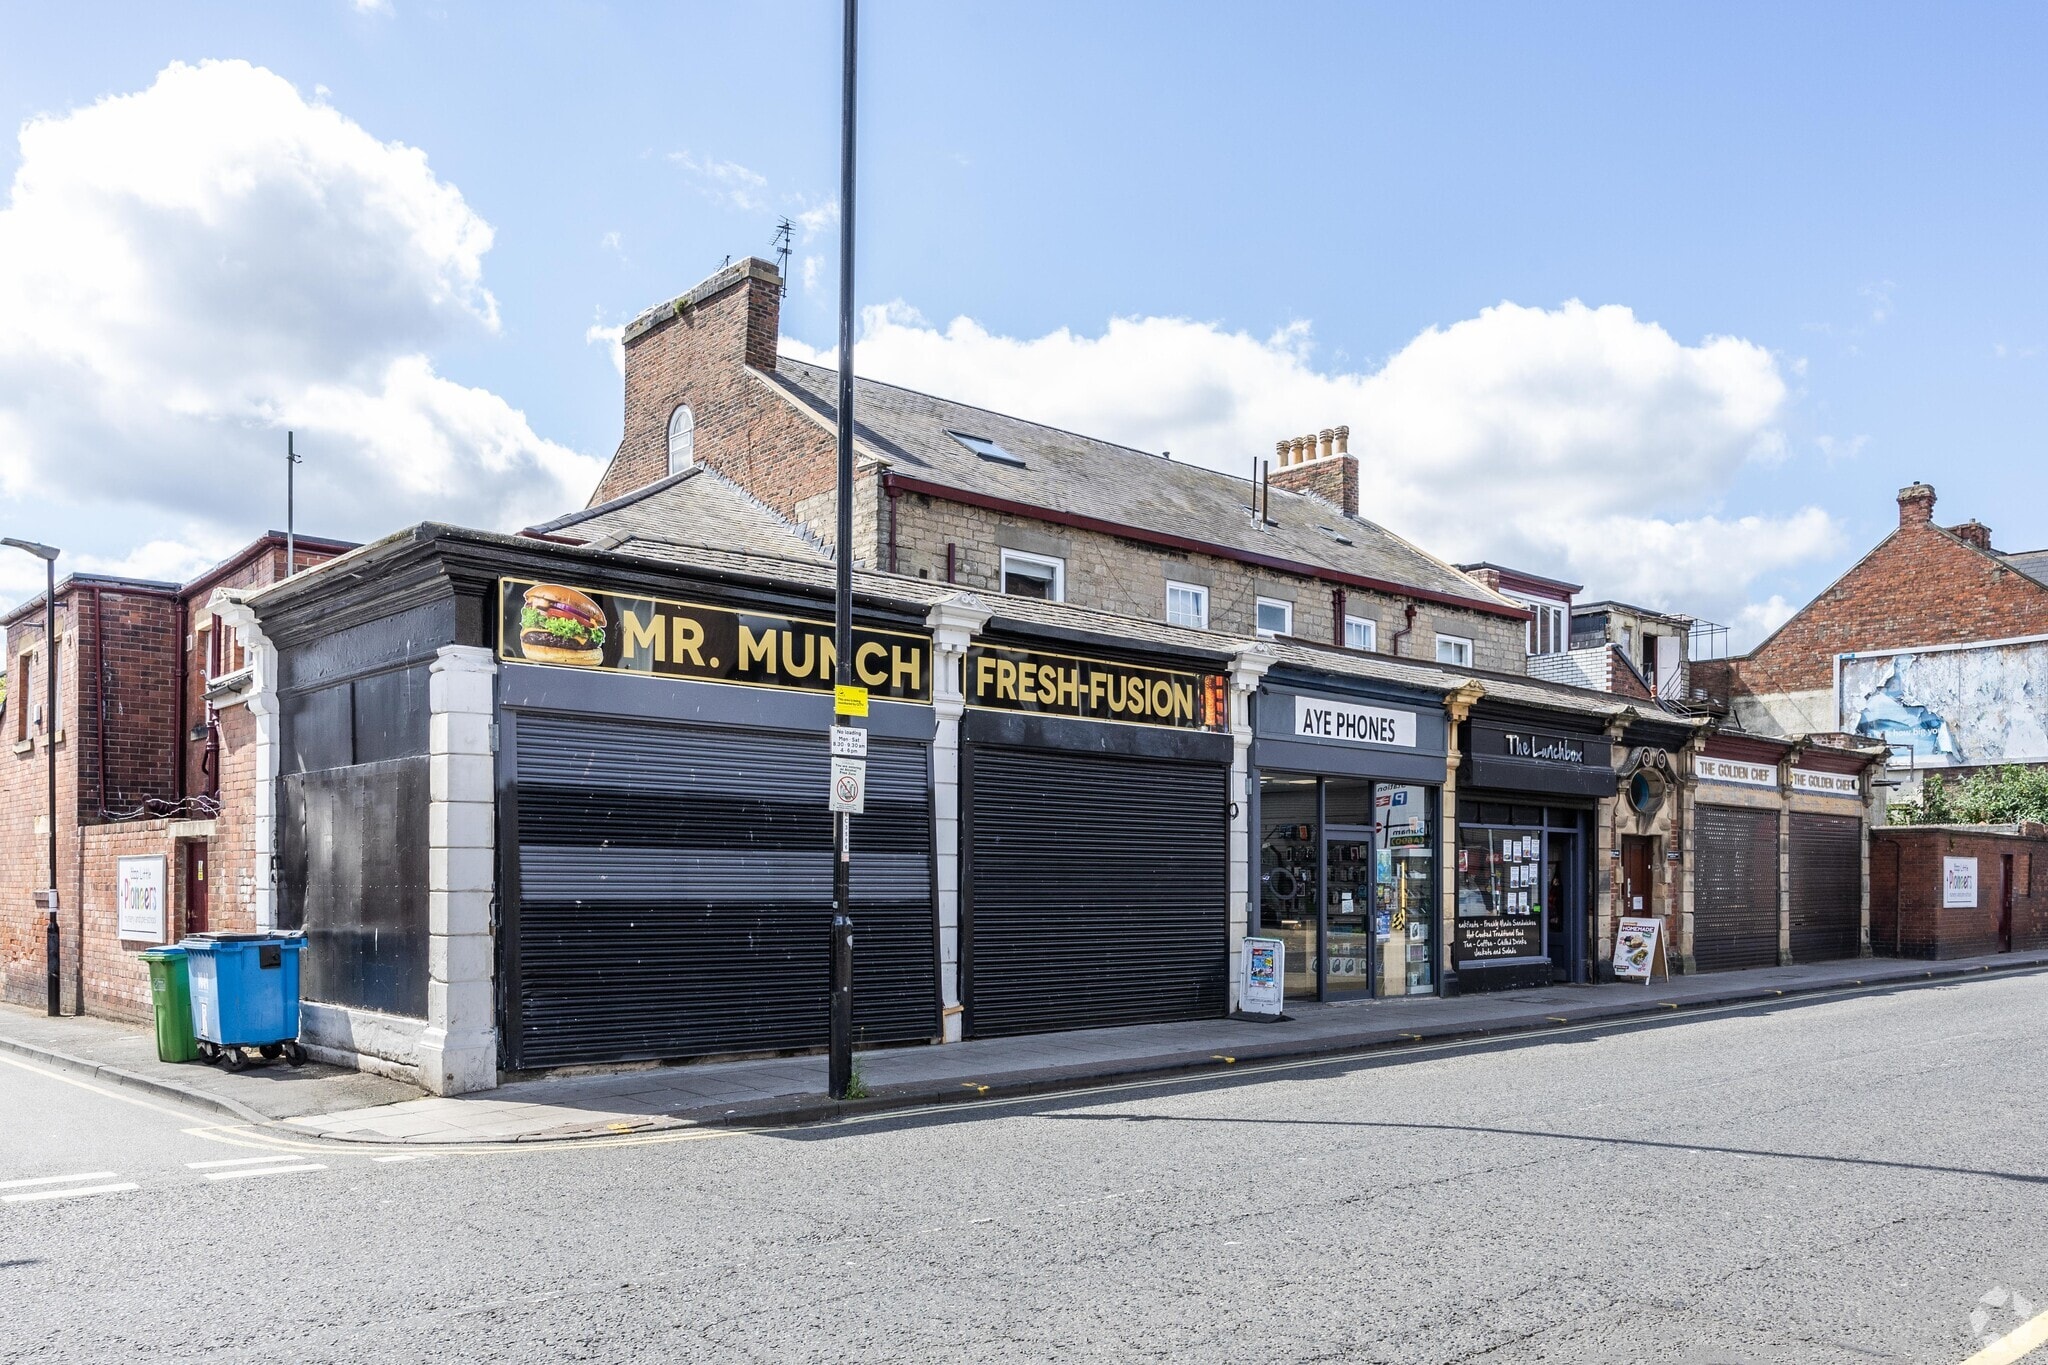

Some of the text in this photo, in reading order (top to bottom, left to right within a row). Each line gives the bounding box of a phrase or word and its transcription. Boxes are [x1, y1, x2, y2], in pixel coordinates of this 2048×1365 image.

[623, 610, 720, 668] MR.
[977, 656, 1193, 720] FRESH-FUSION
[1303, 708, 1396, 743] AYE PHONES
[1505, 734, 1583, 762] The Lunchbox
[1700, 761, 1770, 780] THE GOLDEN CHEF
[1793, 773, 1852, 791] THE GOLDEN CHEF
[124, 878, 157, 911] Pioneers
